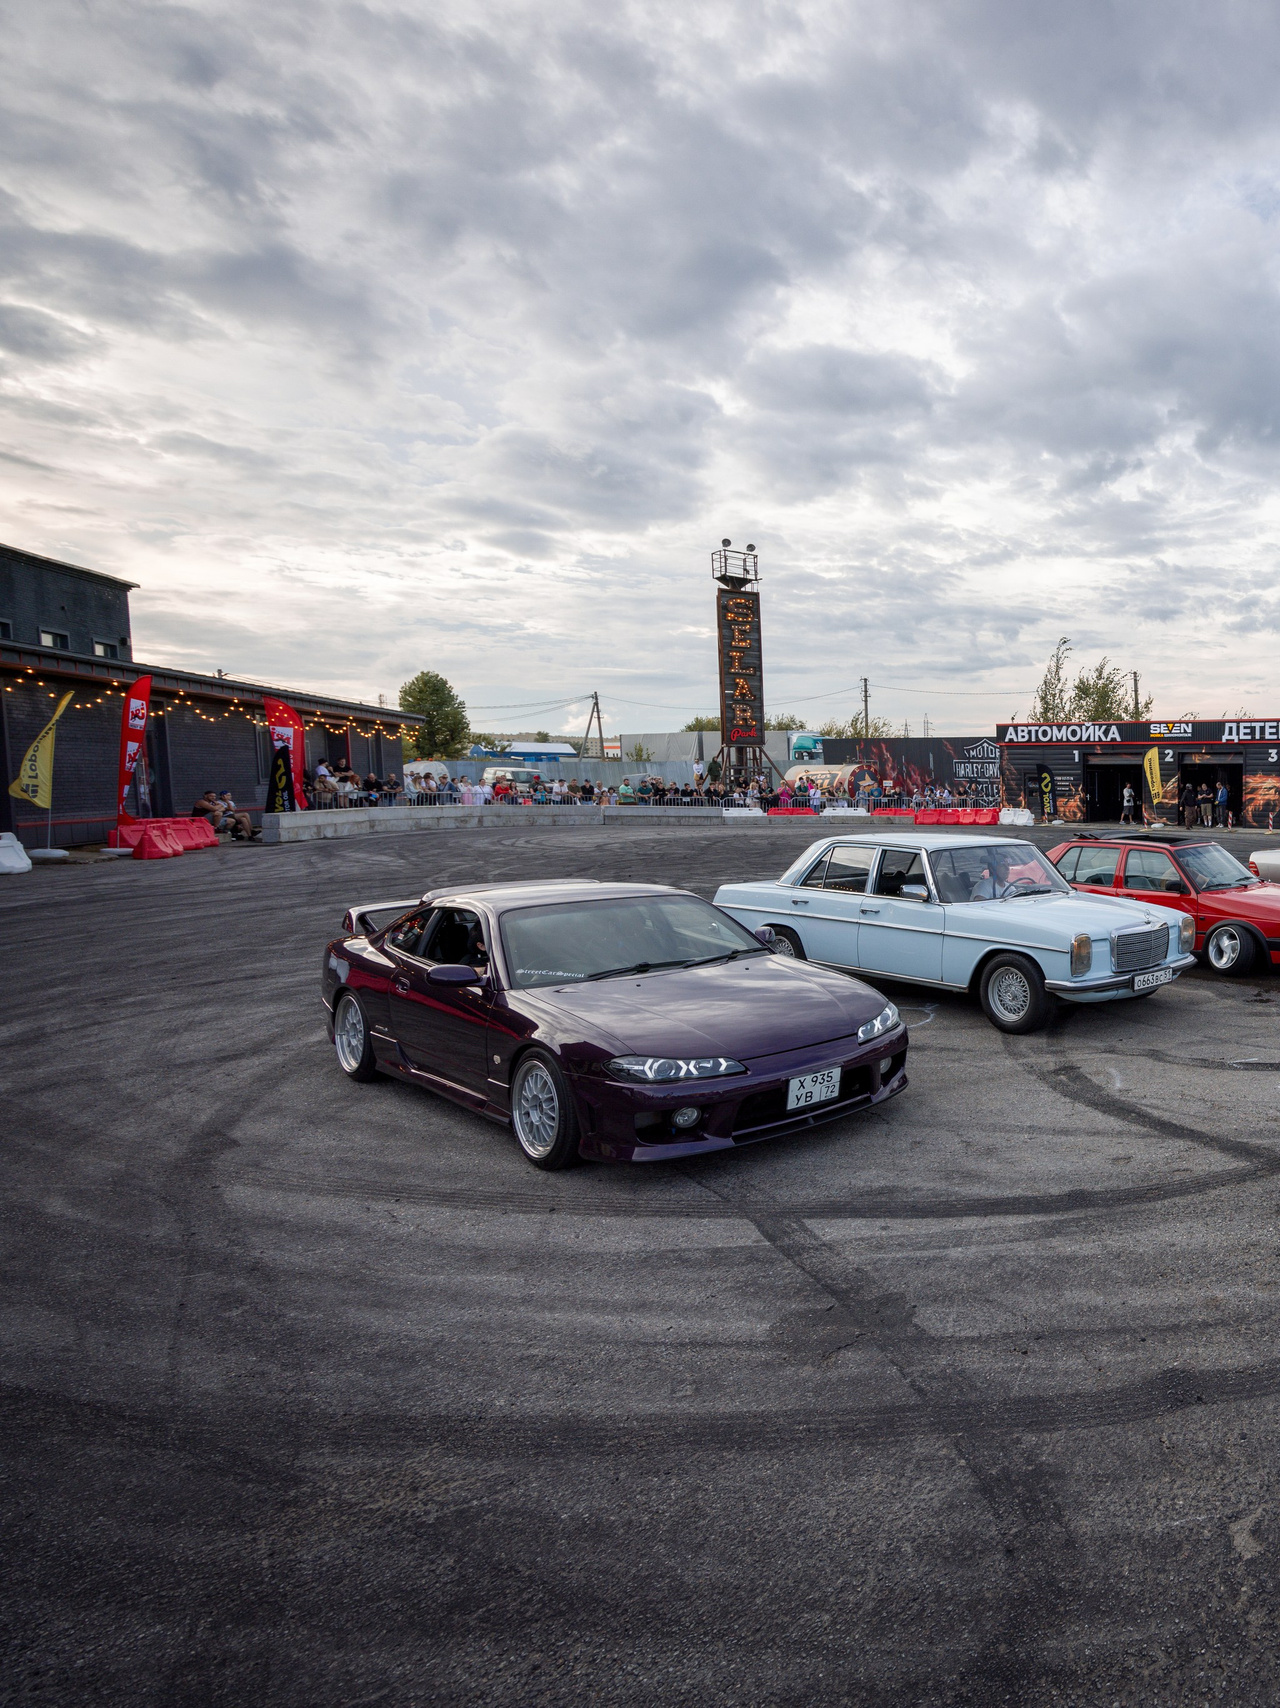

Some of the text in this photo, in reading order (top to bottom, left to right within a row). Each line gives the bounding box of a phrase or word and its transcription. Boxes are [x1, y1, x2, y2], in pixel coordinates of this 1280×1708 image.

[726, 597, 757, 727] SELAR
[730, 726, 758, 741] Park
[1004, 722, 1121, 743] АВТОМОЙКА
[1073, 750, 1079, 762] 1
[1164, 749, 1174, 762] 2
[1268, 749, 1278, 763] 3
[274, 790, 284, 813] VOL
[1043, 793, 1051, 813] AVOL
[797, 1071, 833, 1091] Х 935
[795, 1084, 836, 1106] УВ 72
